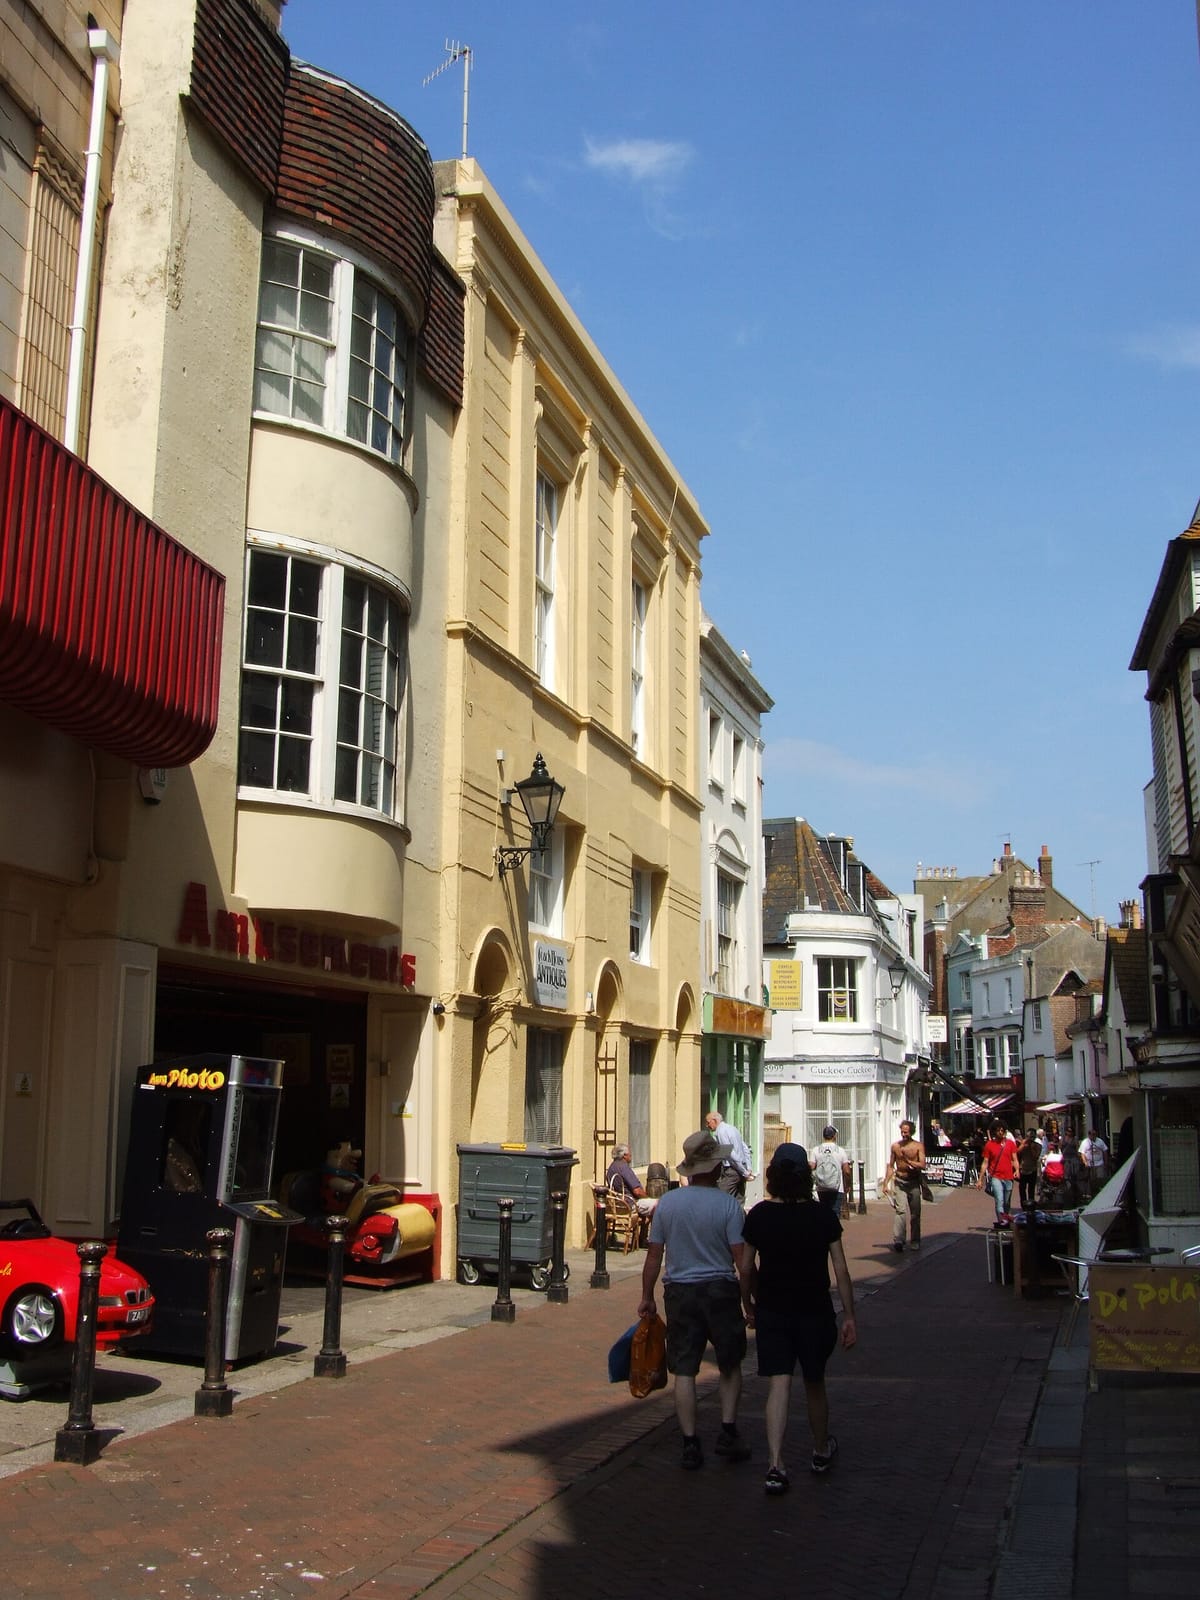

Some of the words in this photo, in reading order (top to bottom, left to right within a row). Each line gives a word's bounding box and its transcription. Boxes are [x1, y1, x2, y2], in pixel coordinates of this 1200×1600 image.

[537, 965, 567, 989] ANTIQUES
[167, 1068, 225, 1091] Photo
[810, 1065, 844, 1074] Cuckoo
[847, 1066, 872, 1074] Cuckoo
[1095, 1288, 1127, 1317] Di
